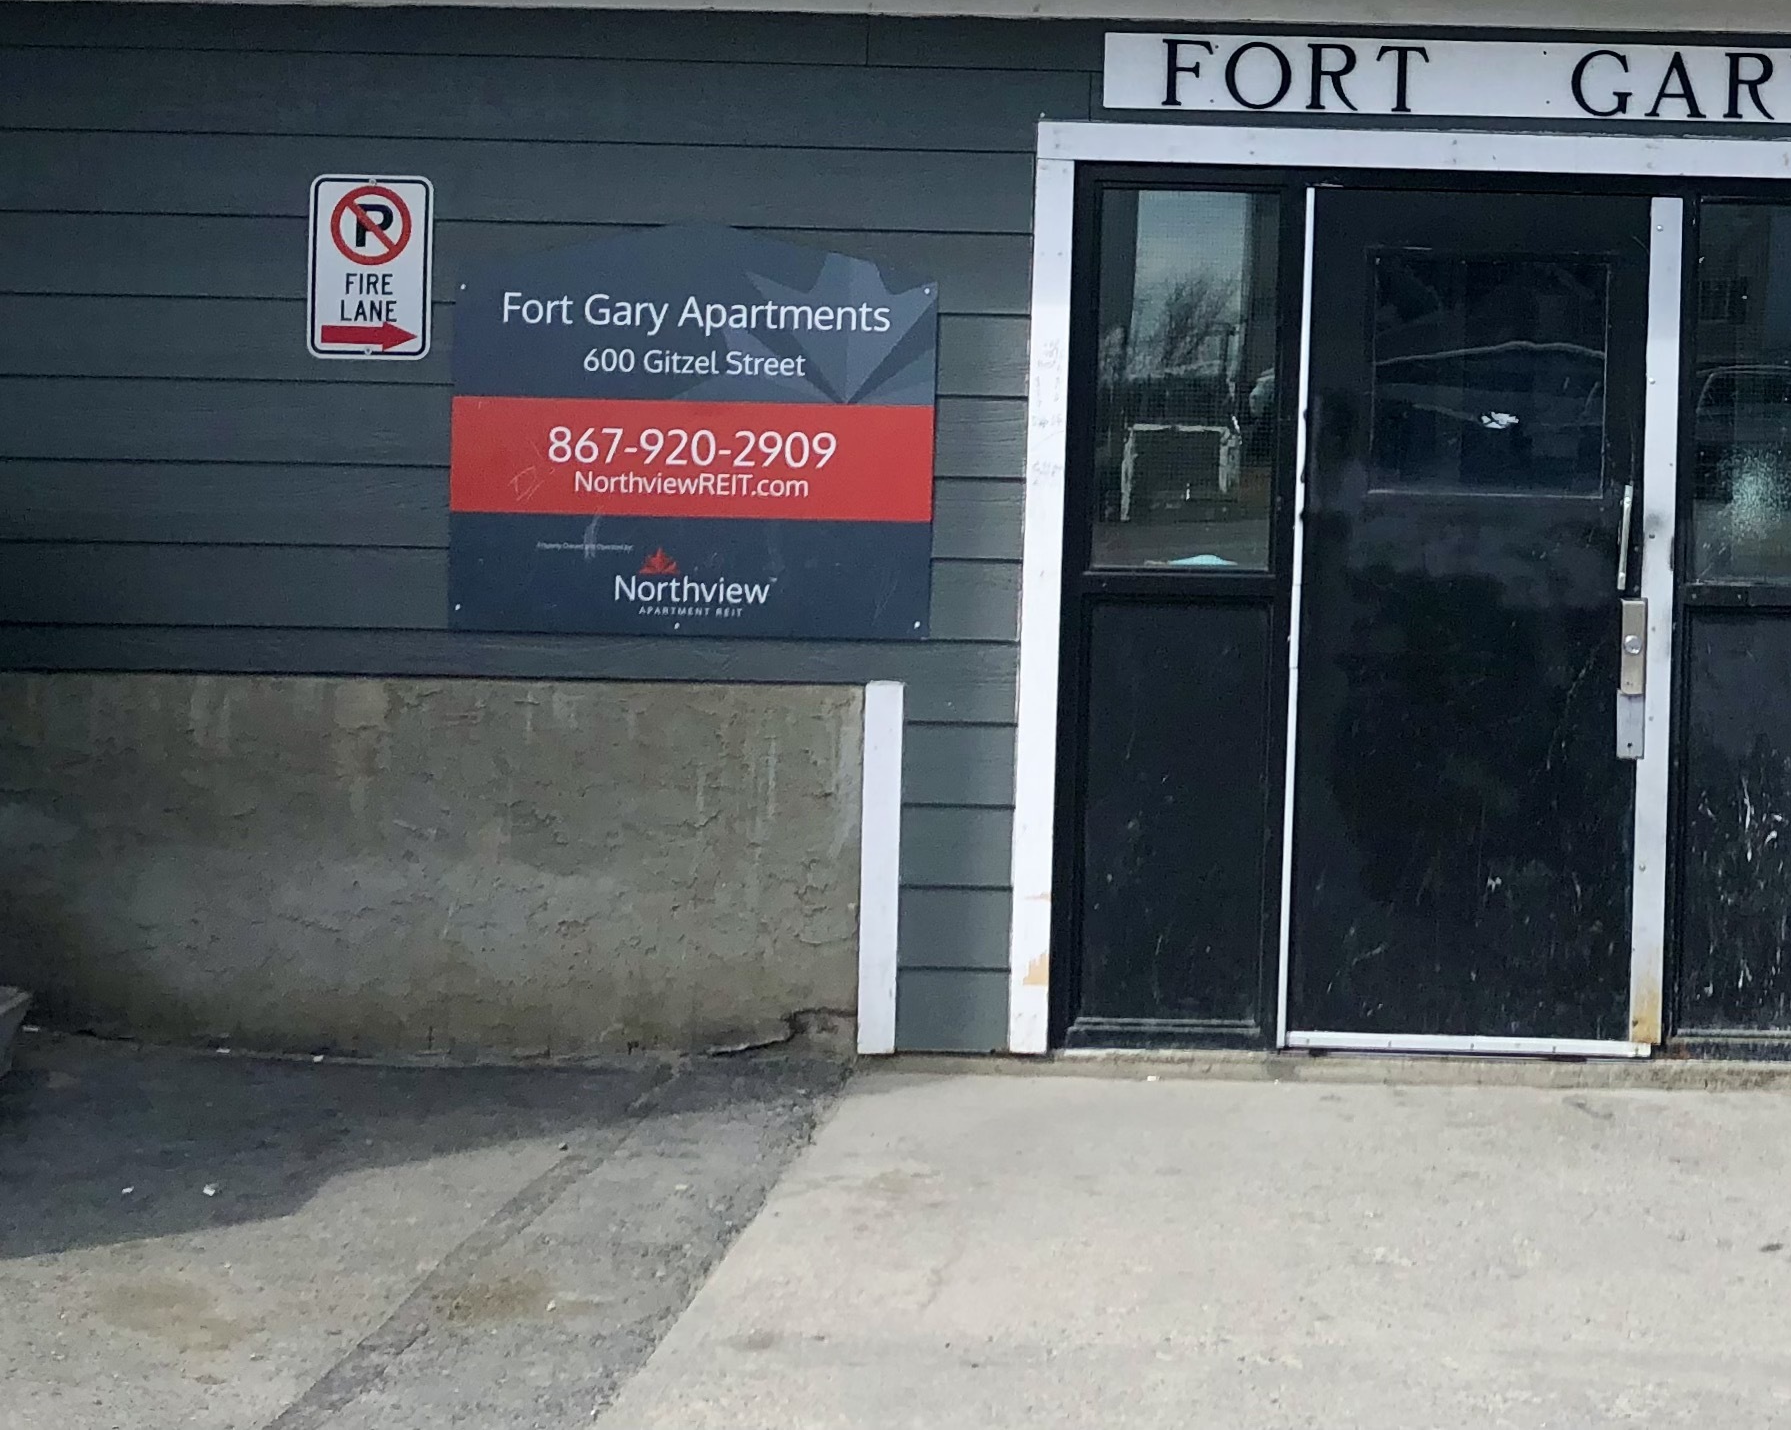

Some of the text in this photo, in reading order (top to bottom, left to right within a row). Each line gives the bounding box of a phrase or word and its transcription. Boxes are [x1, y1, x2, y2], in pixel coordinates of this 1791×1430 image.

[1161, 37, 1431, 114] FORT
[345, 272, 394, 296] FIRE
[339, 299, 398, 323] LANE
[502, 292, 892, 336] Fort Gary Apartments
[583, 348, 806, 377] 600 Gitzel Street
[548, 426, 838, 469] 867-920-2909
[574, 470, 809, 498] NorthviewREIT.com
[614, 574, 770, 604] Northview
[638, 605, 743, 618] APARTMENT REIT
